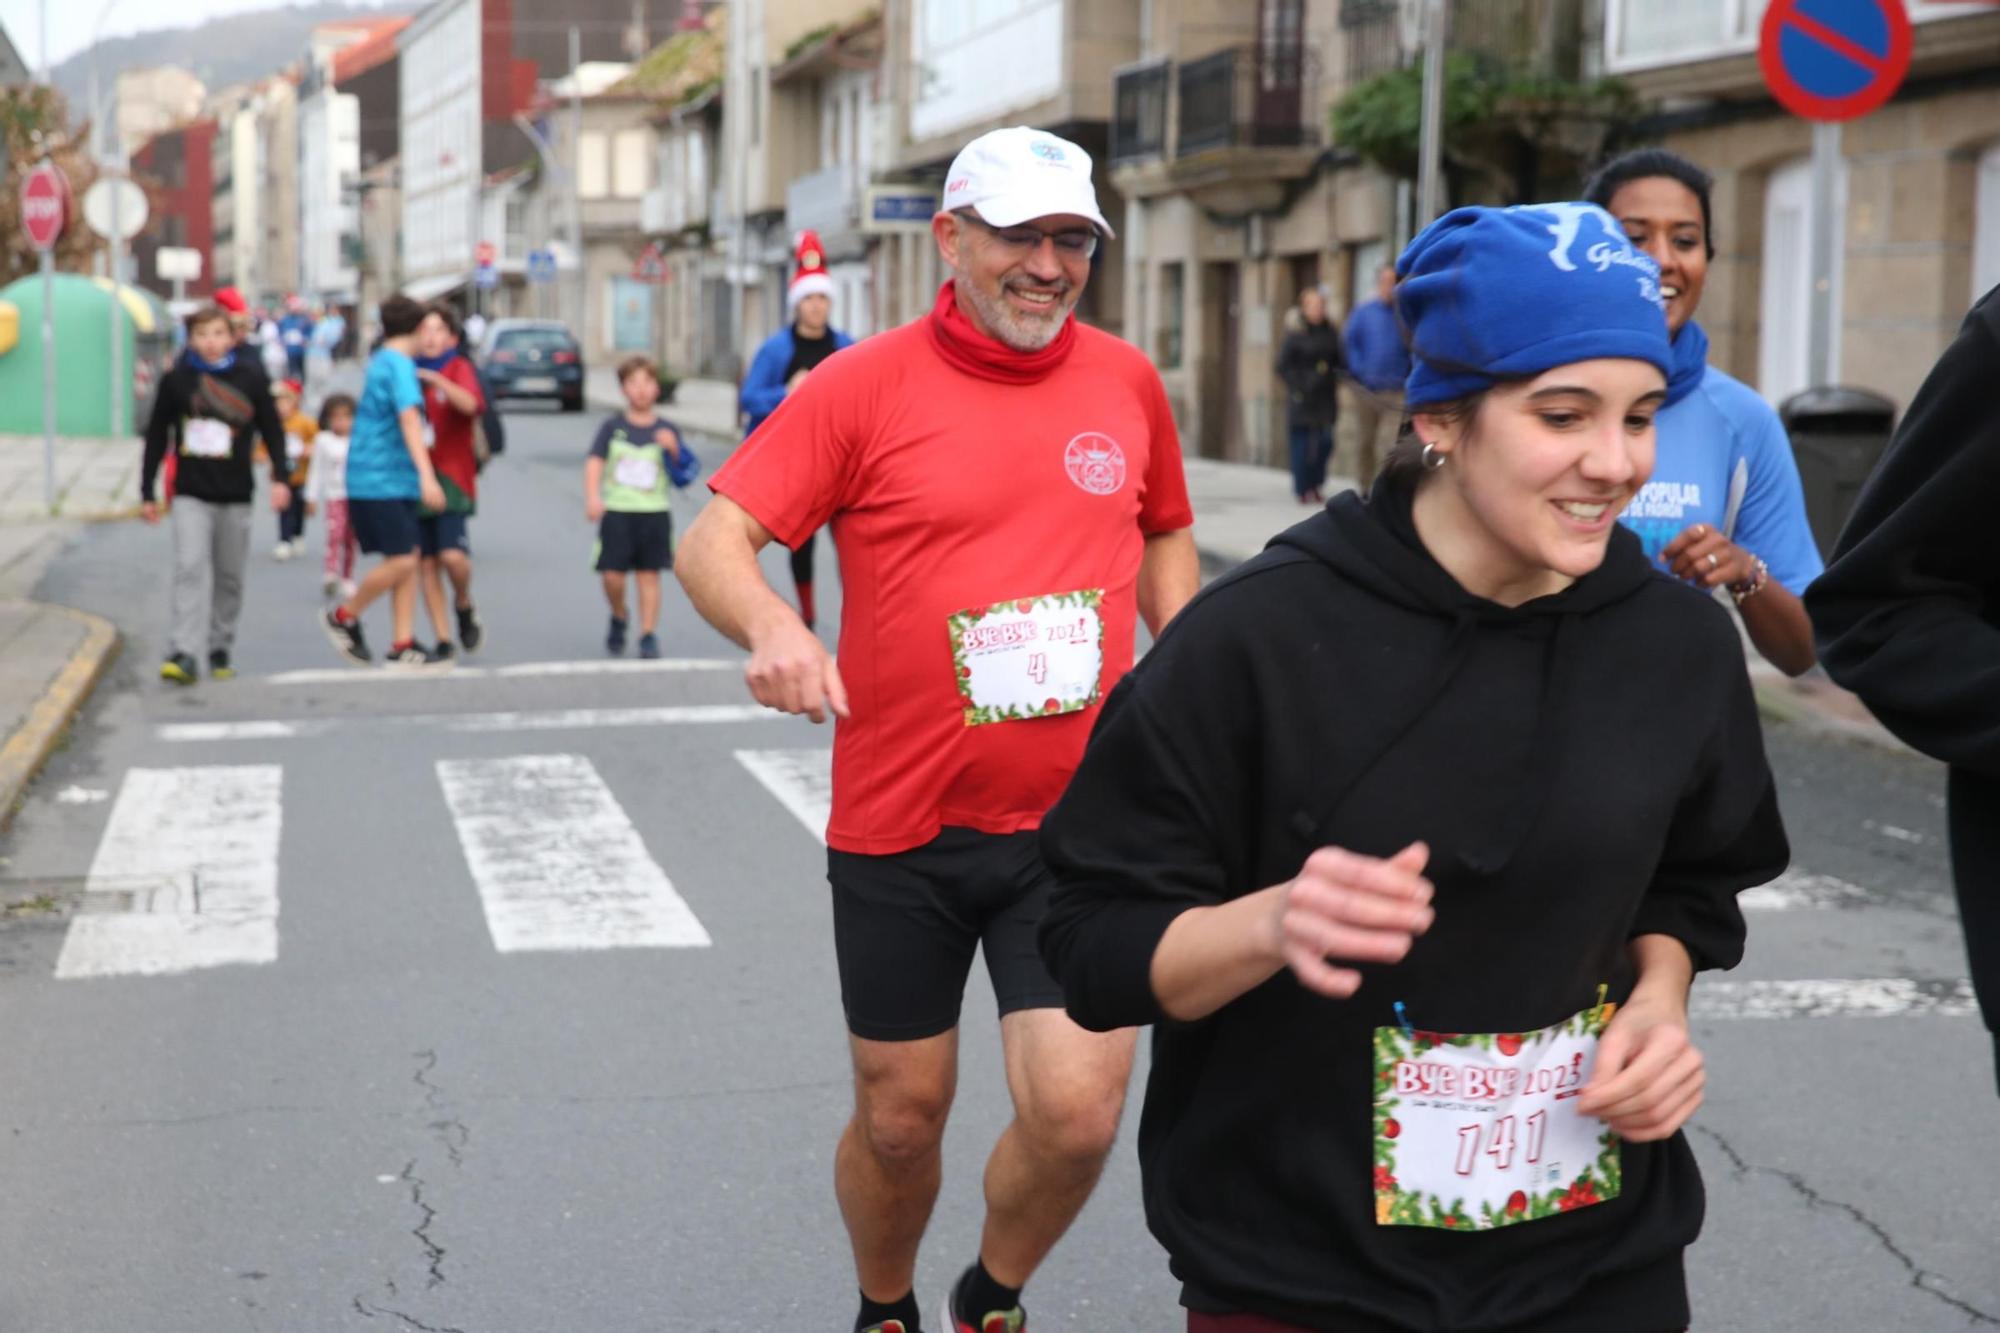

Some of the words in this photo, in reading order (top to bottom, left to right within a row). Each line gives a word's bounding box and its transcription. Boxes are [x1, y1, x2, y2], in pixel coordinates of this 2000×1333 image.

[1640, 482, 1701, 506] POPULAR
[1027, 652, 1047, 685] 4
[1455, 1109, 1546, 1176] 141
